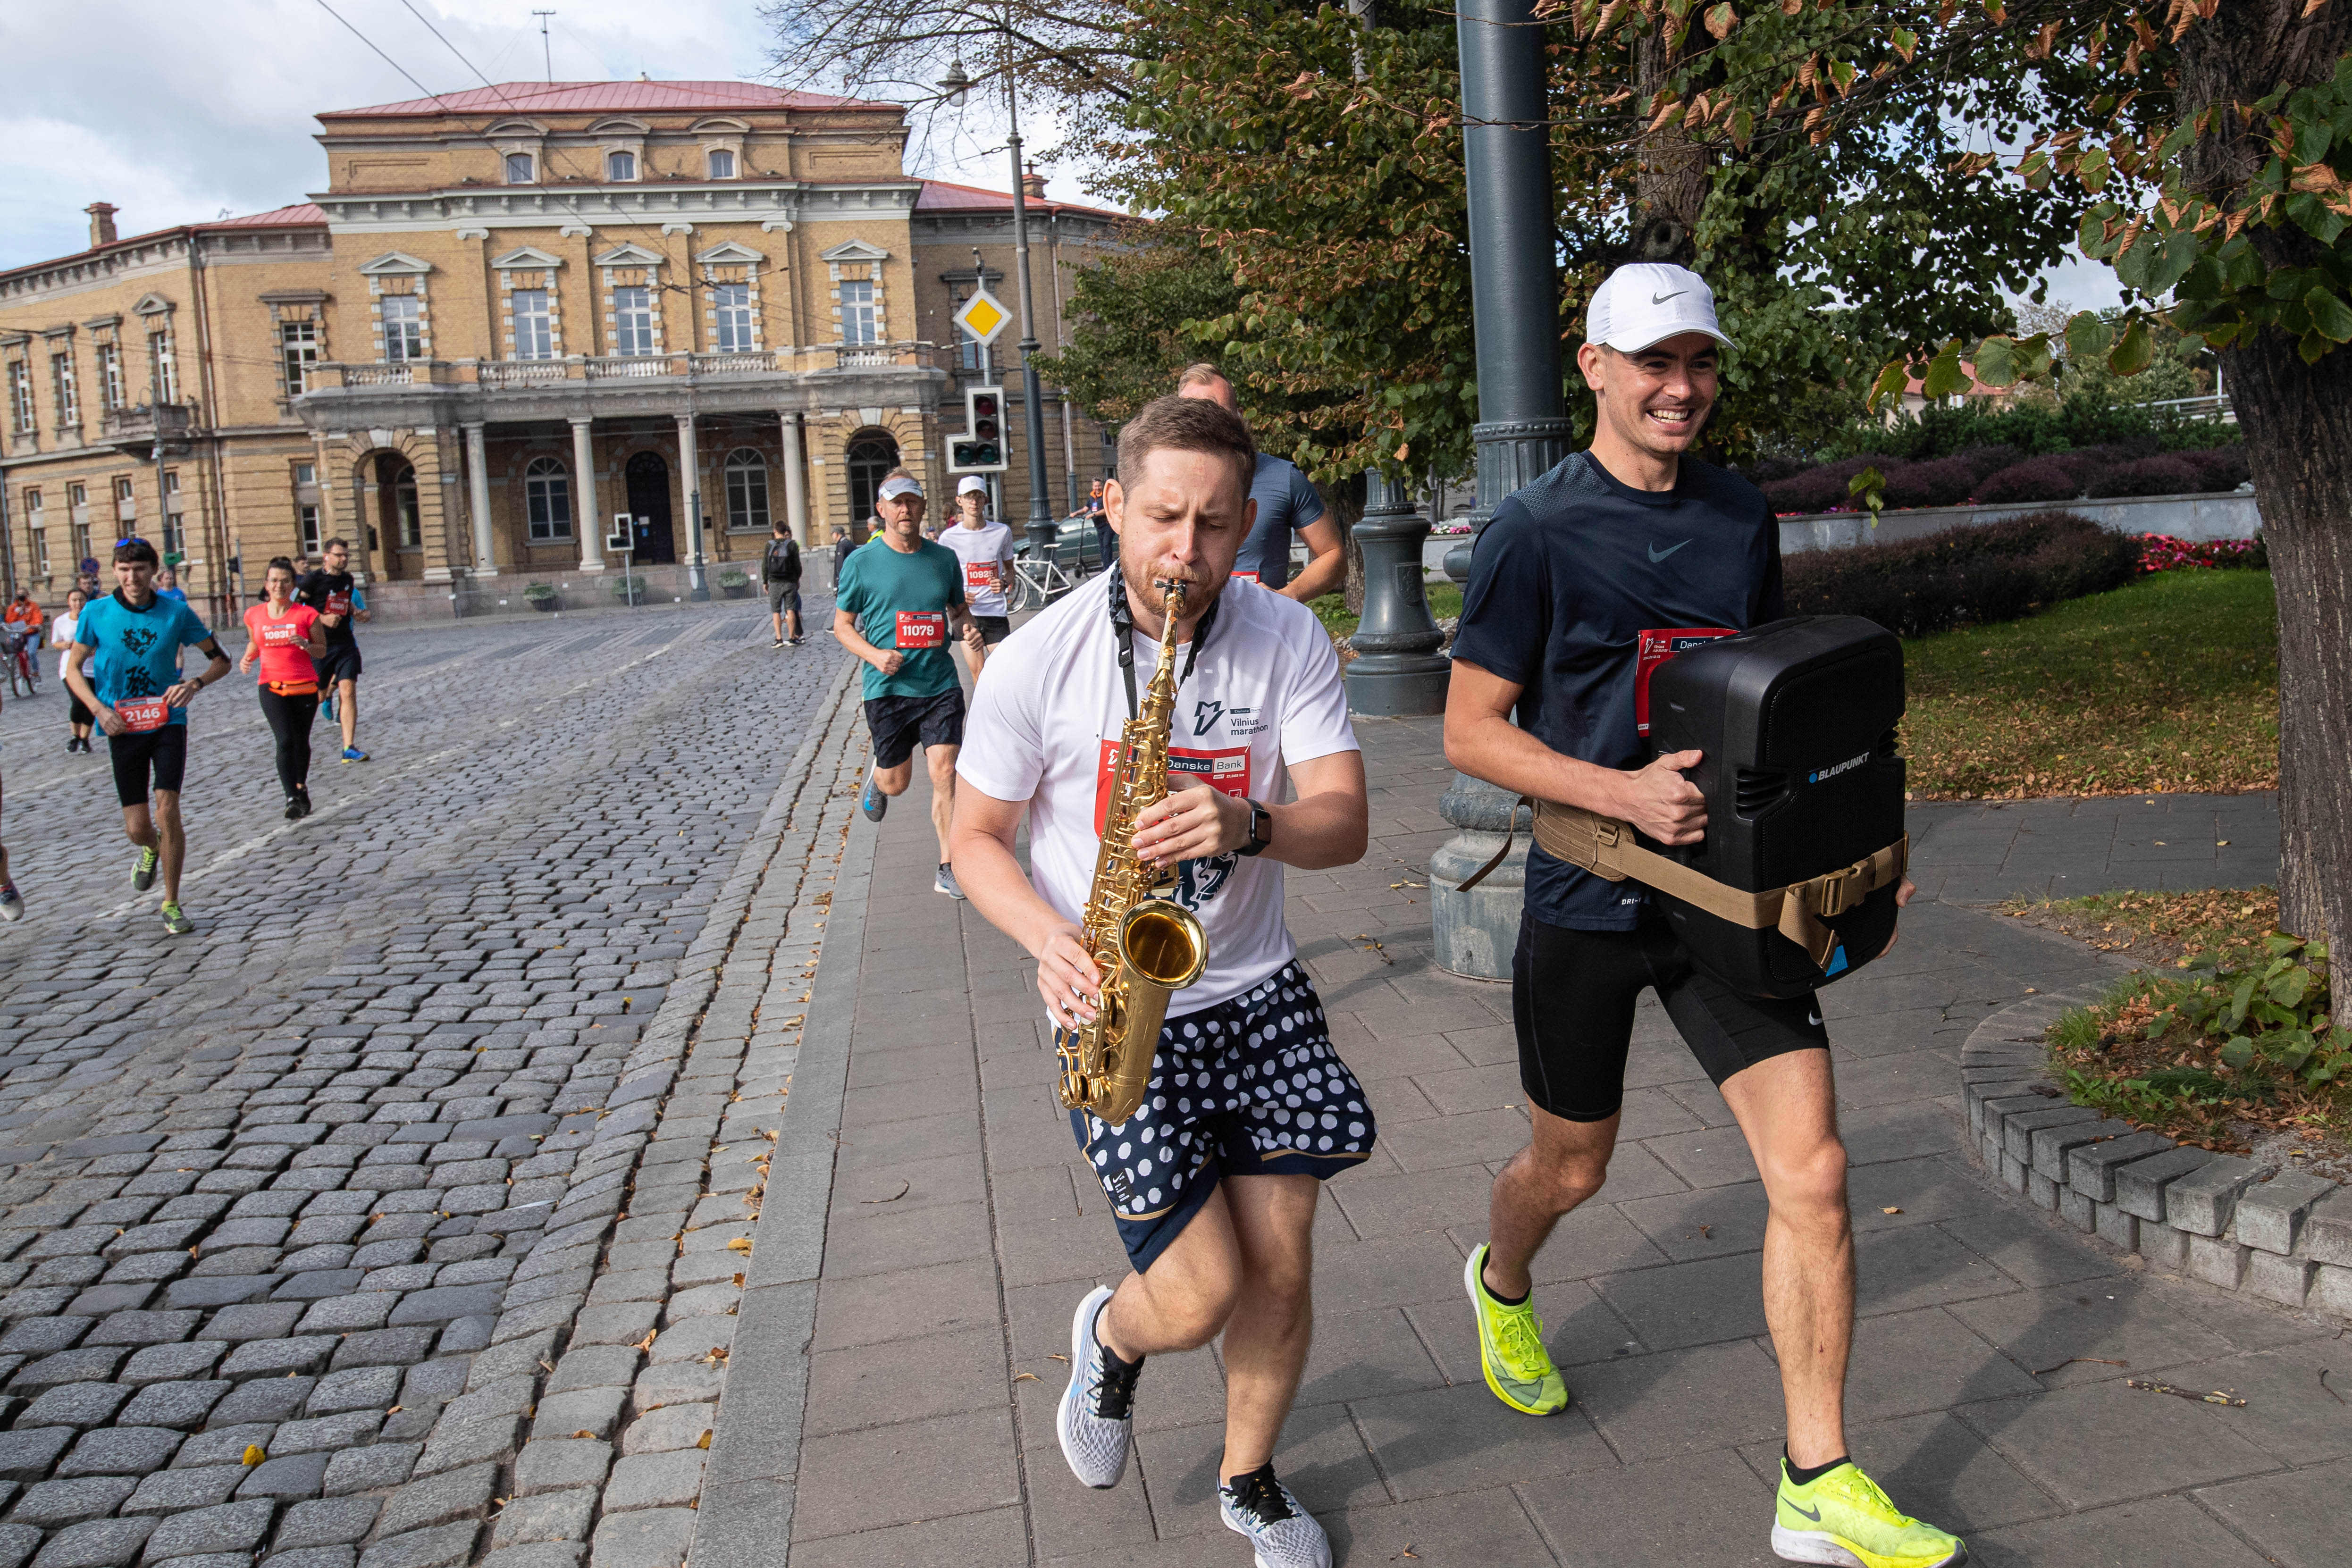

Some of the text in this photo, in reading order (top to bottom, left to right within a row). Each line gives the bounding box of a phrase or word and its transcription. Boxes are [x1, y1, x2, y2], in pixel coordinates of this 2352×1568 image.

[902, 625, 934, 636] 11079
[126, 707, 160, 722] 2146
[1231, 718, 1259, 727] Vilnius
[1231, 724, 1268, 735] marathon
[1217, 760, 1242, 770] Bank
[1818, 752, 1869, 781] BLAUPUNKT
